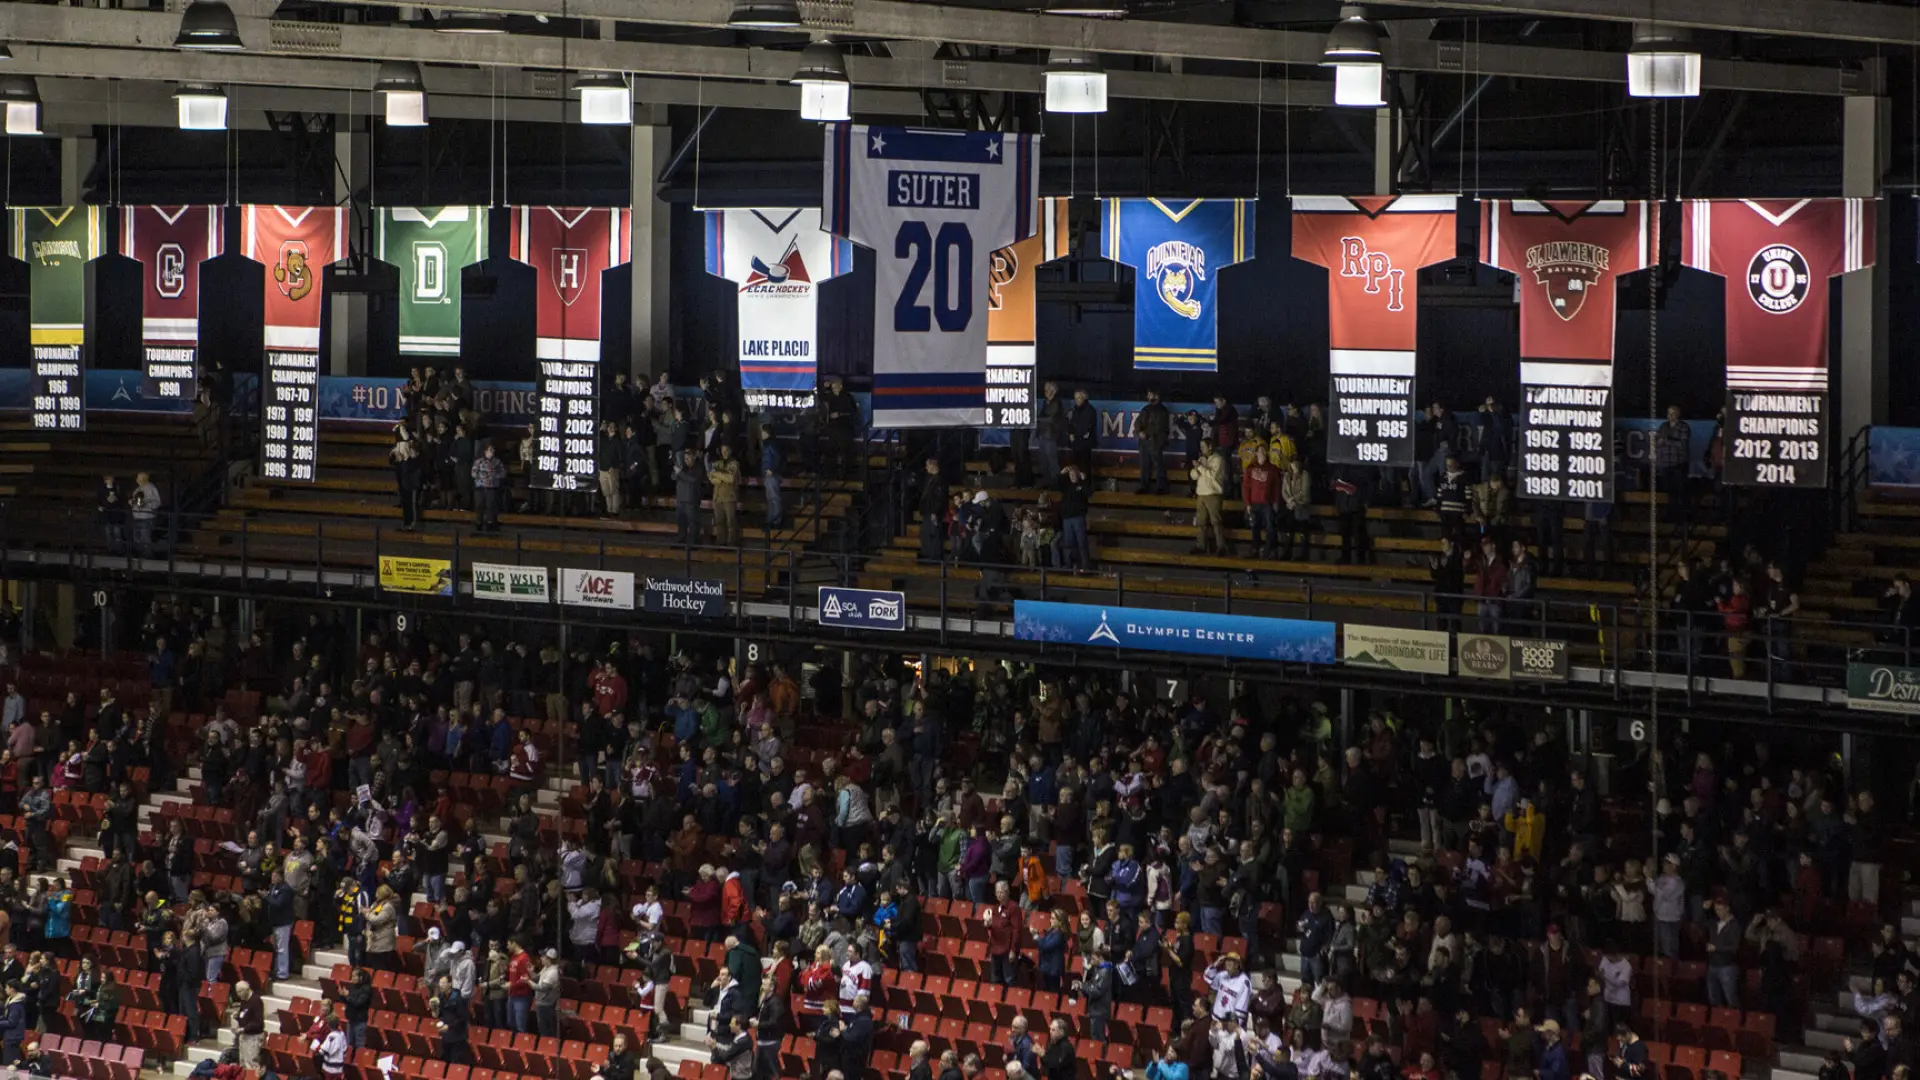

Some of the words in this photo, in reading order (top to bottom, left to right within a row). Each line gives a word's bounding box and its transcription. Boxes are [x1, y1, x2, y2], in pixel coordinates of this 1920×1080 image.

[897, 174, 971, 207] SUTER
[157, 243, 184, 297] C
[412, 241, 448, 304] D
[560, 254, 579, 289] H
[894, 220, 973, 332] 20
[1341, 237, 1404, 311] RPI
[1547, 266, 1587, 274] SAINTS
[1769, 268, 1787, 290] U
[747, 285, 775, 293] ECAC
[775, 285, 811, 293] HOCKEY
[34, 346, 79, 361] TOURNAMENT
[146, 348, 194, 362] TOURNAMENT
[742, 340, 769, 356] LAKE
[771, 340, 810, 357] PLACID
[37, 363, 79, 377] CHAMPIONS
[149, 364, 193, 378] CHAMPIONS
[540, 361, 595, 378] TOURNAMENT
[986, 368, 1032, 384] RNAMENT
[276, 387, 310, 402] 1967-70
[1334, 377, 1411, 395] TOURNAMENT
[34, 396, 56, 411] 1991
[59, 396, 80, 411] 1999
[352, 385, 388, 410] #10
[985, 388, 1029, 403] MPIONS
[1526, 387, 1609, 407] TOURNAMENT
[1735, 394, 1821, 413] TOURNAMENT
[568, 400, 593, 416] 1994
[1339, 398, 1408, 416] CHAMPIONS
[33, 413, 56, 428] 1993
[59, 414, 80, 429] 2007
[1001, 408, 1031, 425] 2008
[1529, 409, 1602, 428] CHAMPIONS
[564, 419, 594, 436] 2002
[1102, 411, 1187, 440] MAK
[1337, 419, 1368, 437] 1984
[1376, 420, 1408, 438] 1985
[1739, 416, 1819, 436] CHAMPIONS
[564, 438, 594, 455] 2004
[1524, 429, 1560, 448] 1962
[1568, 431, 1602, 450] 1992
[265, 443, 287, 459] 1986
[1356, 443, 1388, 461] 1995
[1734, 439, 1771, 458] 2012
[1779, 440, 1819, 460] 2013
[264, 462, 286, 477] 1996
[565, 457, 594, 474] 2006
[1524, 453, 1560, 472] 1988
[1568, 455, 1605, 475] 2000
[1757, 463, 1796, 483] 2014
[552, 474, 577, 490] 2015
[1524, 476, 1560, 496] 1989
[1568, 479, 1604, 499] 2001
[475, 570, 505, 585] WSLP
[510, 573, 544, 586] WSLP
[582, 575, 614, 595] ACE
[645, 578, 693, 594] Northwood
[694, 581, 722, 595] School
[92, 590, 107, 607] 10
[582, 595, 614, 604] Hardware
[662, 593, 706, 615] Hockey
[842, 602, 857, 611] SCA
[870, 606, 897, 617] TORK
[396, 614, 407, 631] 9
[1127, 623, 1190, 638] OLYMPIC
[1195, 629, 1255, 643] CENTER
[747, 645, 758, 662] 8
[1374, 644, 1426, 660] ADIRONDACK
[1429, 649, 1445, 661] LIFE
[1463, 651, 1504, 662] DANCING
[1522, 647, 1554, 659] GOOD
[1522, 657, 1554, 668] FOOD
[1166, 679, 1178, 698] 7
[1630, 720, 1645, 741] 6
